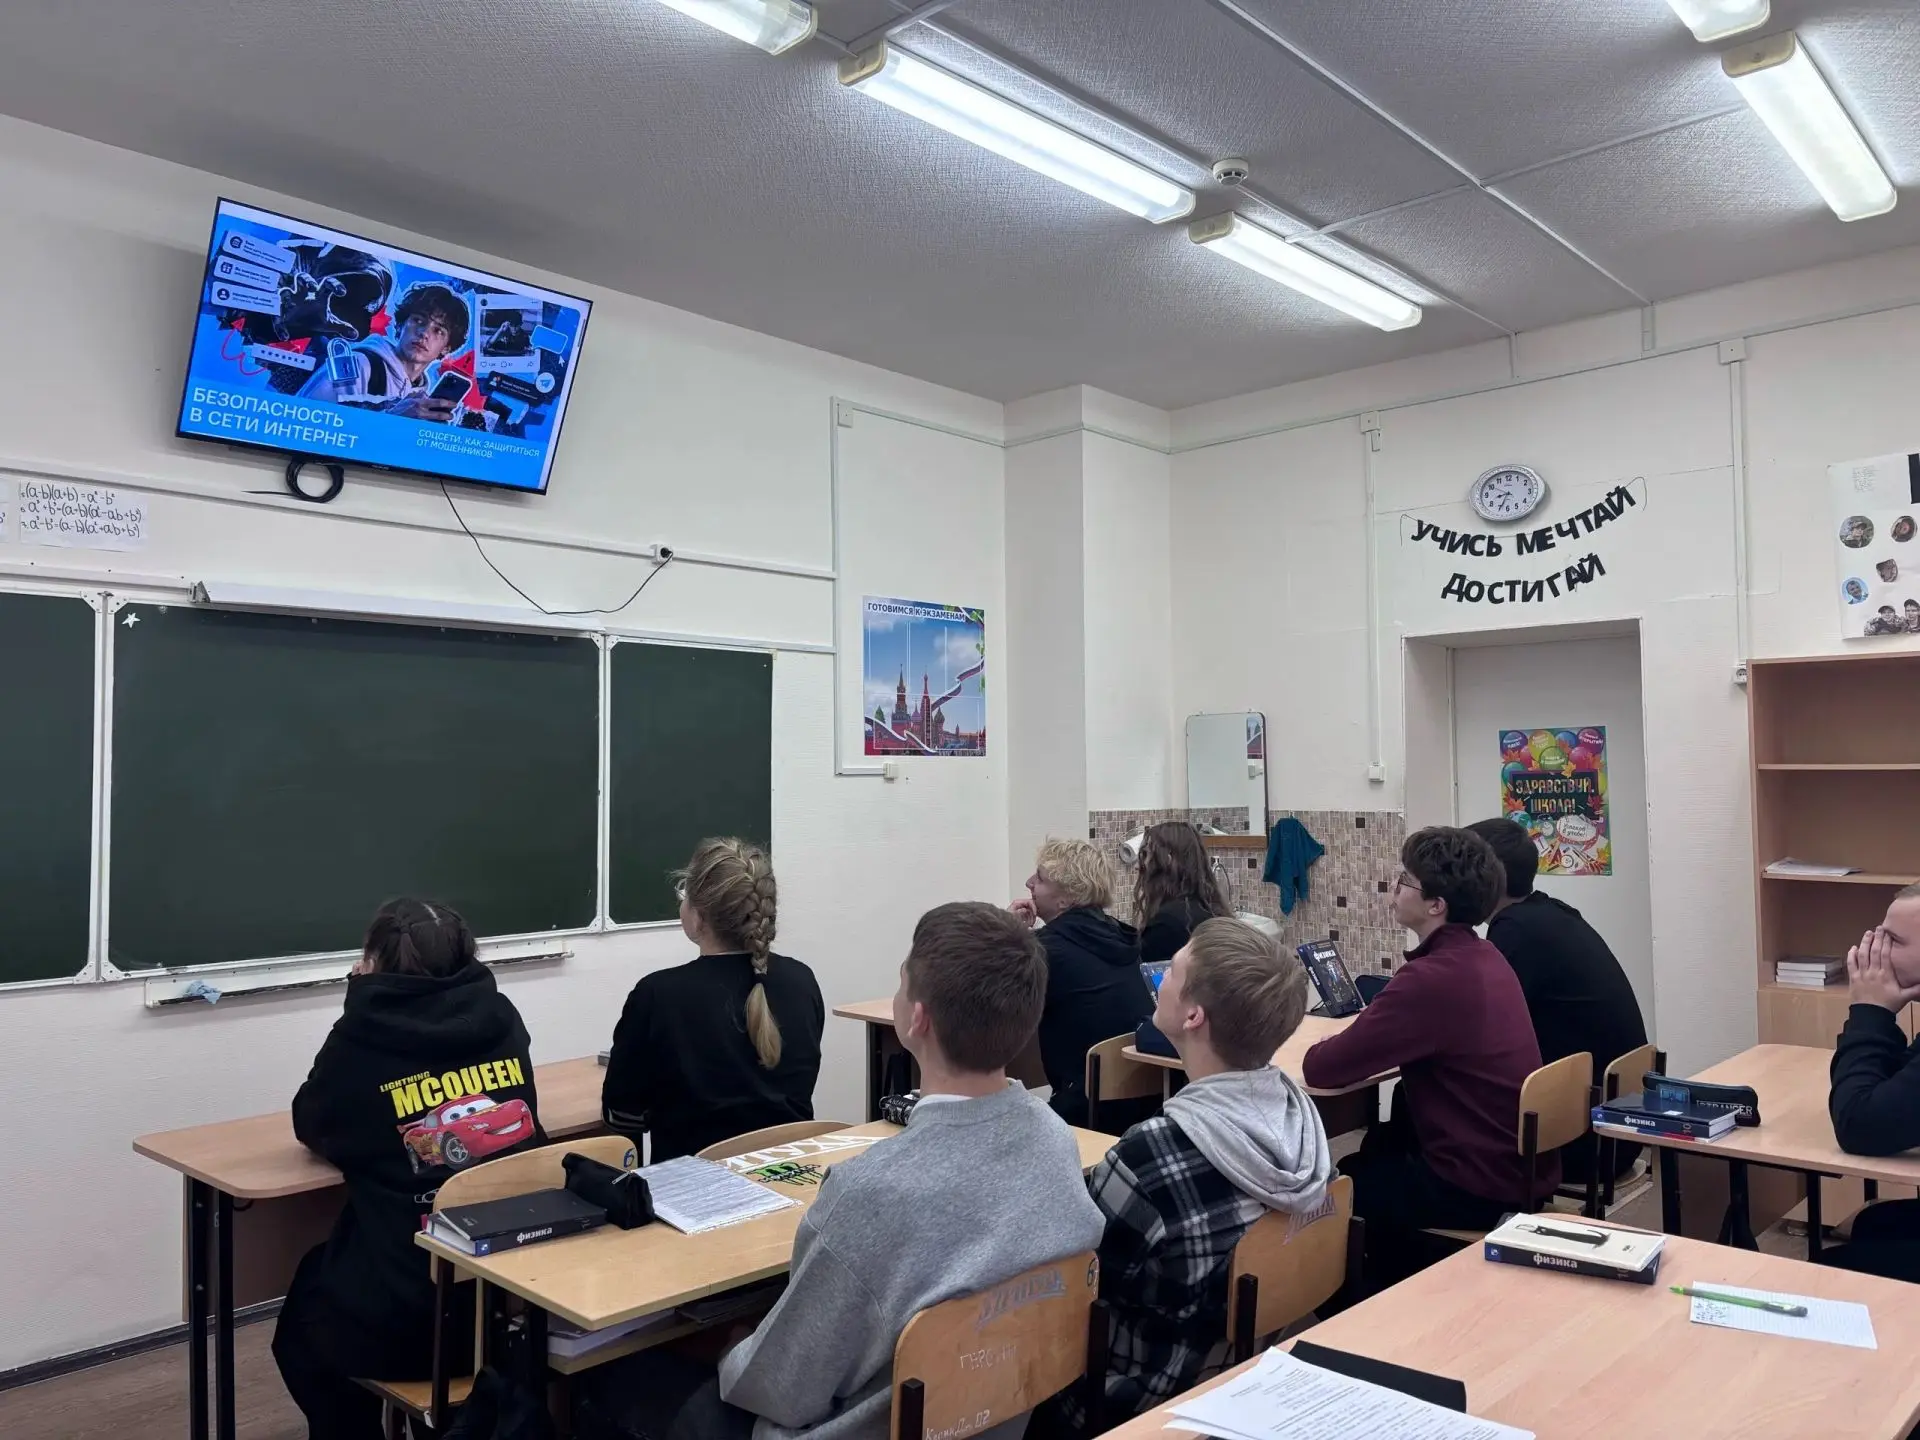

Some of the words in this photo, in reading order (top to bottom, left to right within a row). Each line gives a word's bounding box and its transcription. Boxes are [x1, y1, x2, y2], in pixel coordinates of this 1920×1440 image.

[193, 387, 344, 428] БЕЗОПАСНОСТЬ
[189, 407, 203, 422] В
[207, 410, 259, 433] СЕТИ
[264, 419, 358, 449] ИНТЕРНЕТ
[416, 438, 429, 447] ОТ
[465, 437, 481, 447] КАК
[483, 441, 540, 457] ЗАЩИТИТЬСЯ
[1411, 519, 1502, 557] УЧИСЬ
[1516, 485, 1636, 555] МЕЧТАЙ
[1441, 553, 1606, 604] ДОСТИГАЙ
[867, 602, 914, 615] ГОТОВИМСЯ
[915, 608, 921, 616] К
[922, 609, 966, 622] ЭКЗАМЕНАМ
[1530, 798, 1576, 813] ШКОЛА!
[379, 1070, 430, 1093] LIGHTNING
[390, 1057, 525, 1119] MCQUEEN
[1624, 1115, 1656, 1128] физика
[623, 1148, 635, 1168] 6
[516, 1227, 553, 1243] физика
[1533, 1253, 1578, 1269] физика
